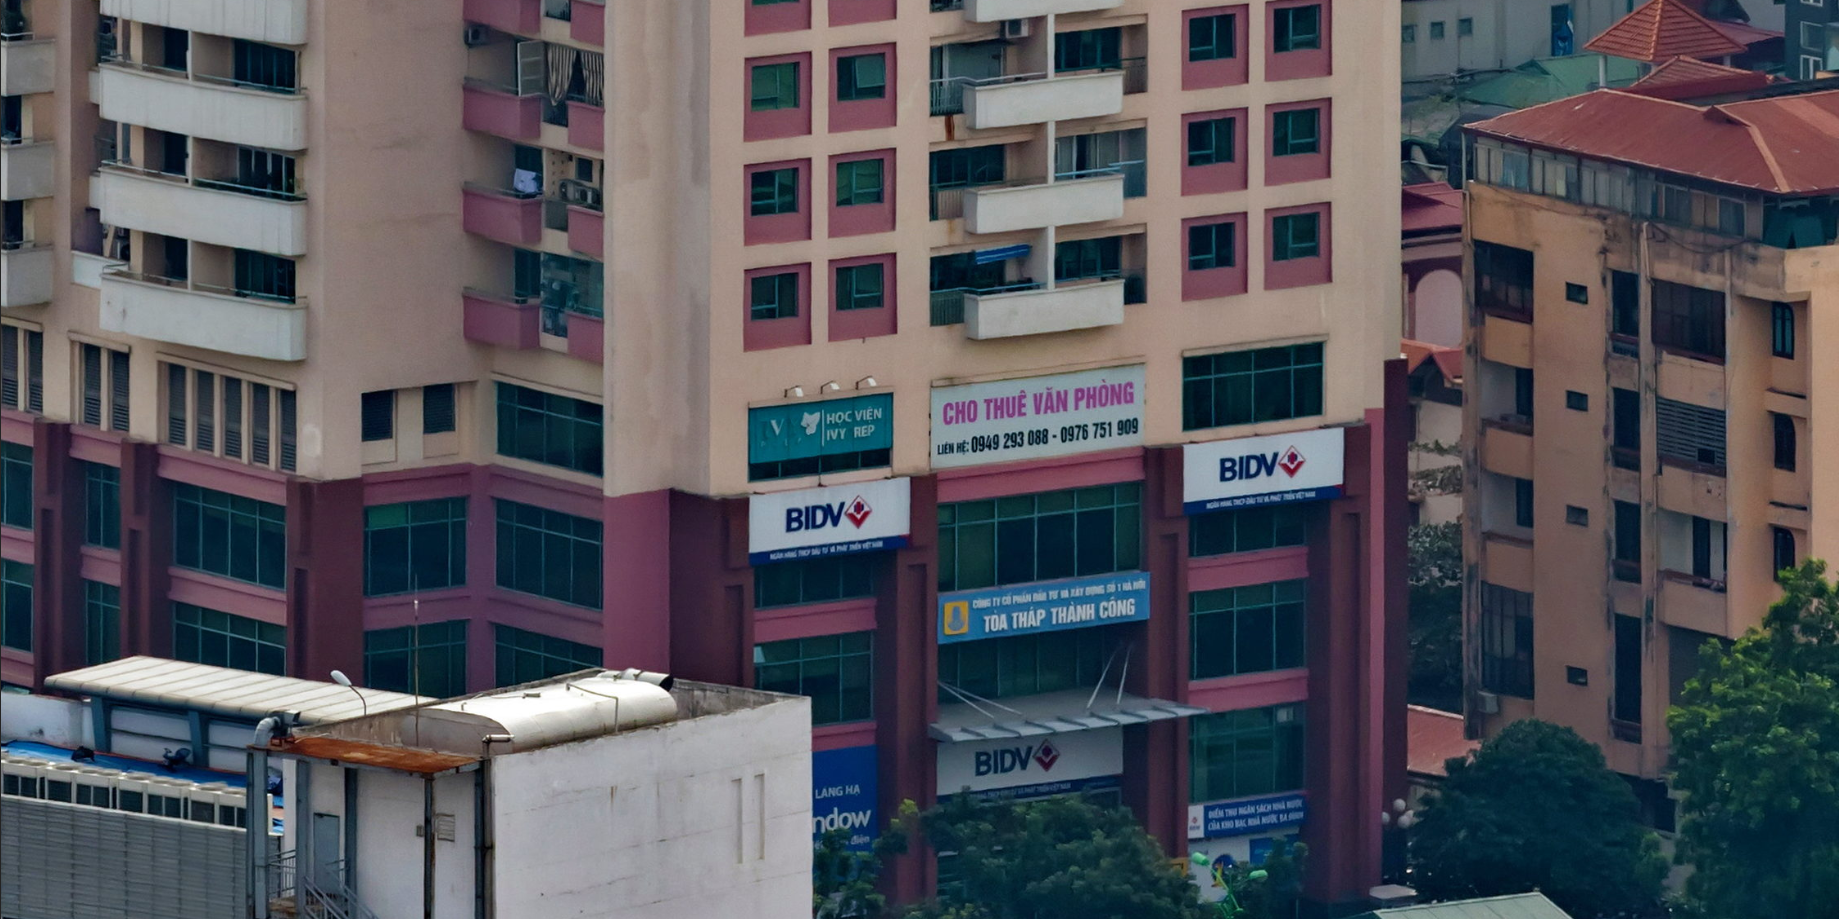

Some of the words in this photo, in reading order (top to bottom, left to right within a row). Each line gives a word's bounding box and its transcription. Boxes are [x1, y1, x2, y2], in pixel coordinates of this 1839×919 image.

[826, 411, 852, 426] HỌC
[854, 406, 883, 423] VIỆN
[942, 399, 978, 426] CHO
[984, 389, 1028, 421] THUÊ
[1032, 387, 1068, 415] VĂN
[1073, 379, 1134, 411] PHÒNG
[826, 428, 847, 441] IVY
[937, 440, 955, 455] LIÊN
[971, 434, 999, 453] 0949
[1003, 431, 1024, 449] 293
[1027, 428, 1049, 446] 088
[1060, 424, 1089, 443] 0976
[1092, 421, 1112, 439] 751
[1117, 418, 1139, 435] 909
[1219, 452, 1279, 482] BIDV
[785, 501, 846, 533] BIDV
[972, 596, 991, 609] CÔNG
[983, 610, 1008, 633] TÒA
[1012, 606, 1046, 629] THÁP
[1051, 601, 1095, 625] THÀNH
[1099, 596, 1136, 619] CÔNG
[975, 745, 1033, 777] BIDV
[845, 784, 861, 796] HẠ
